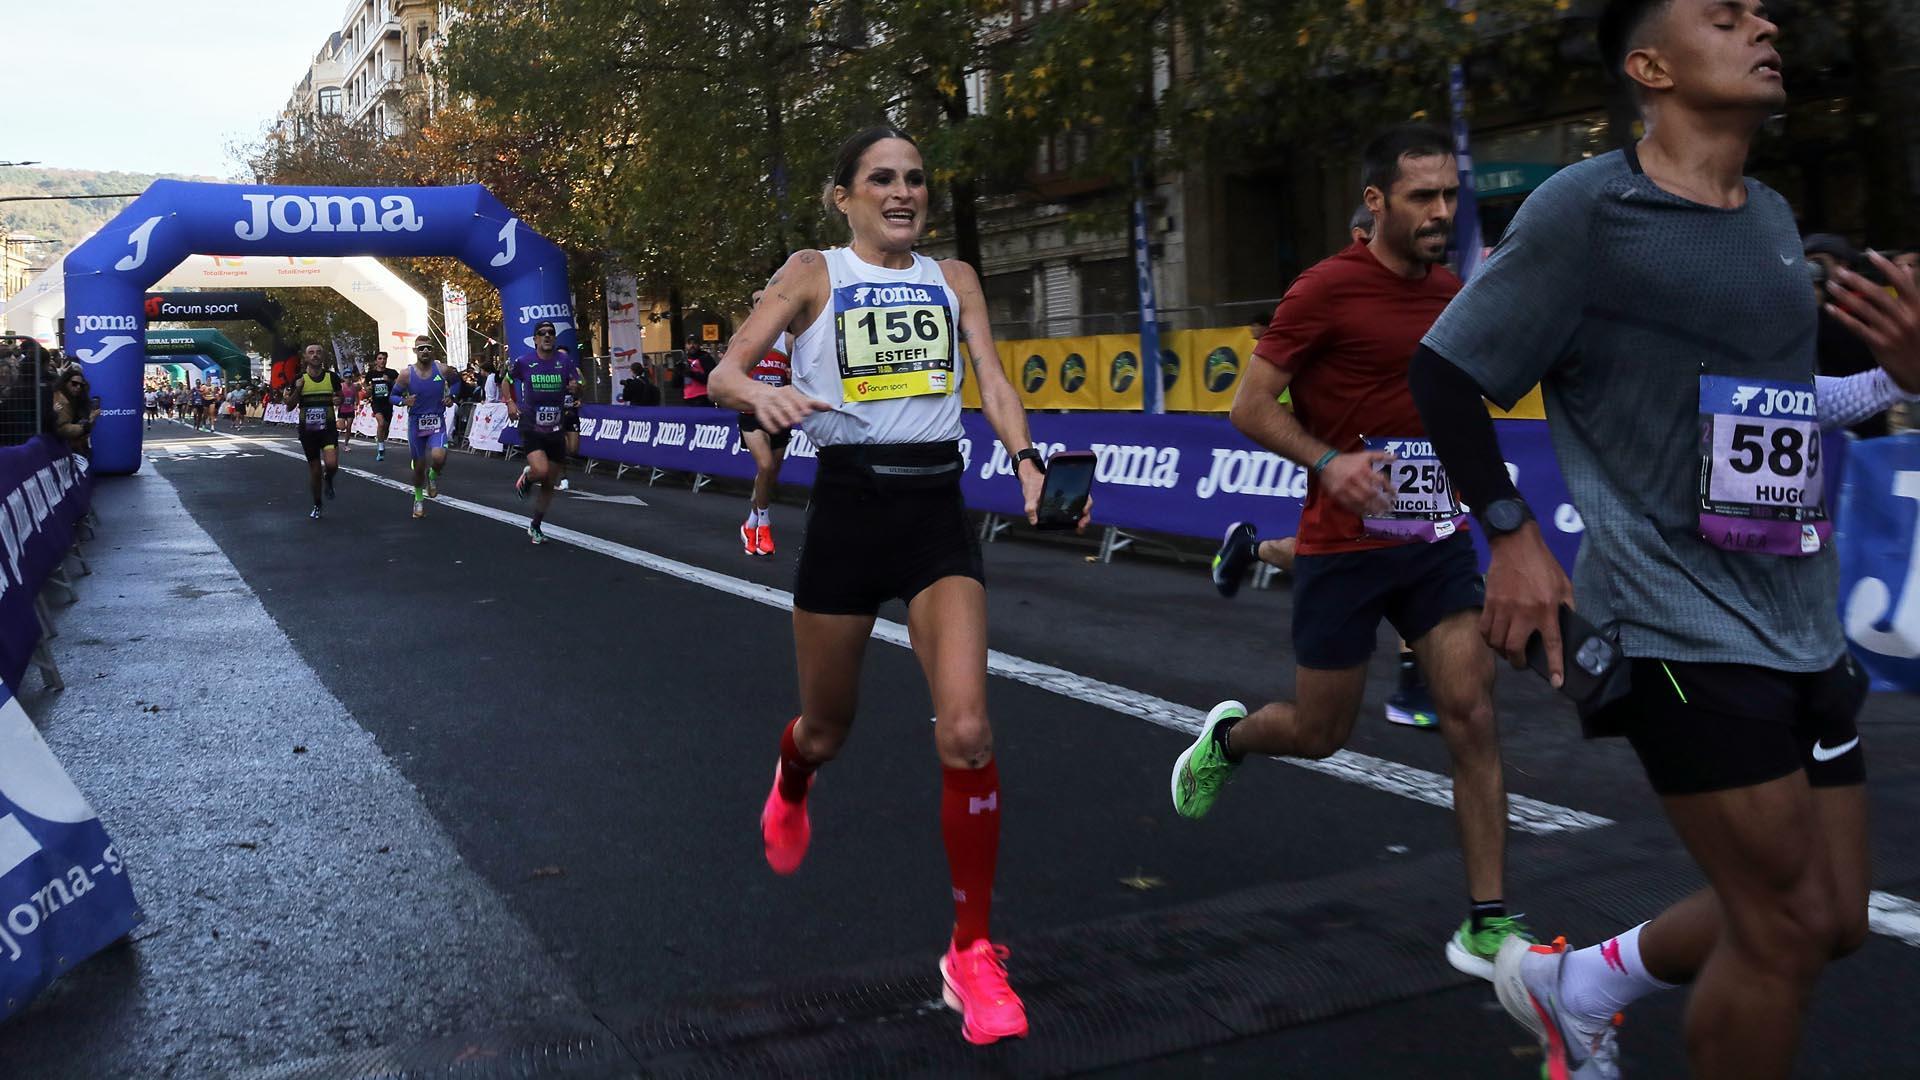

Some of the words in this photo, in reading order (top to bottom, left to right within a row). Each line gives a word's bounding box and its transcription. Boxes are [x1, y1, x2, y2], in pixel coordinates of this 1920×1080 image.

[234, 193, 424, 241] Joma
[203, 269, 248, 277] TotalEnergies
[277, 267, 321, 276] TotalEnergies
[871, 286, 932, 307] Joma
[204, 303, 238, 315] sport
[519, 303, 571, 324] Joma
[75, 315, 138, 334] Joma
[857, 309, 940, 346] 156
[875, 348, 927, 362] ESTEFI
[889, 383, 908, 391] sport
[1759, 387, 1817, 416] Jom
[420, 418, 438, 426] 920
[539, 412, 559, 422] 857
[595, 418, 623, 441] Joma
[622, 419, 652, 444] Joma
[653, 421, 687, 448] Joma
[689, 423, 730, 451] Joma
[1729, 424, 1820, 477] 589
